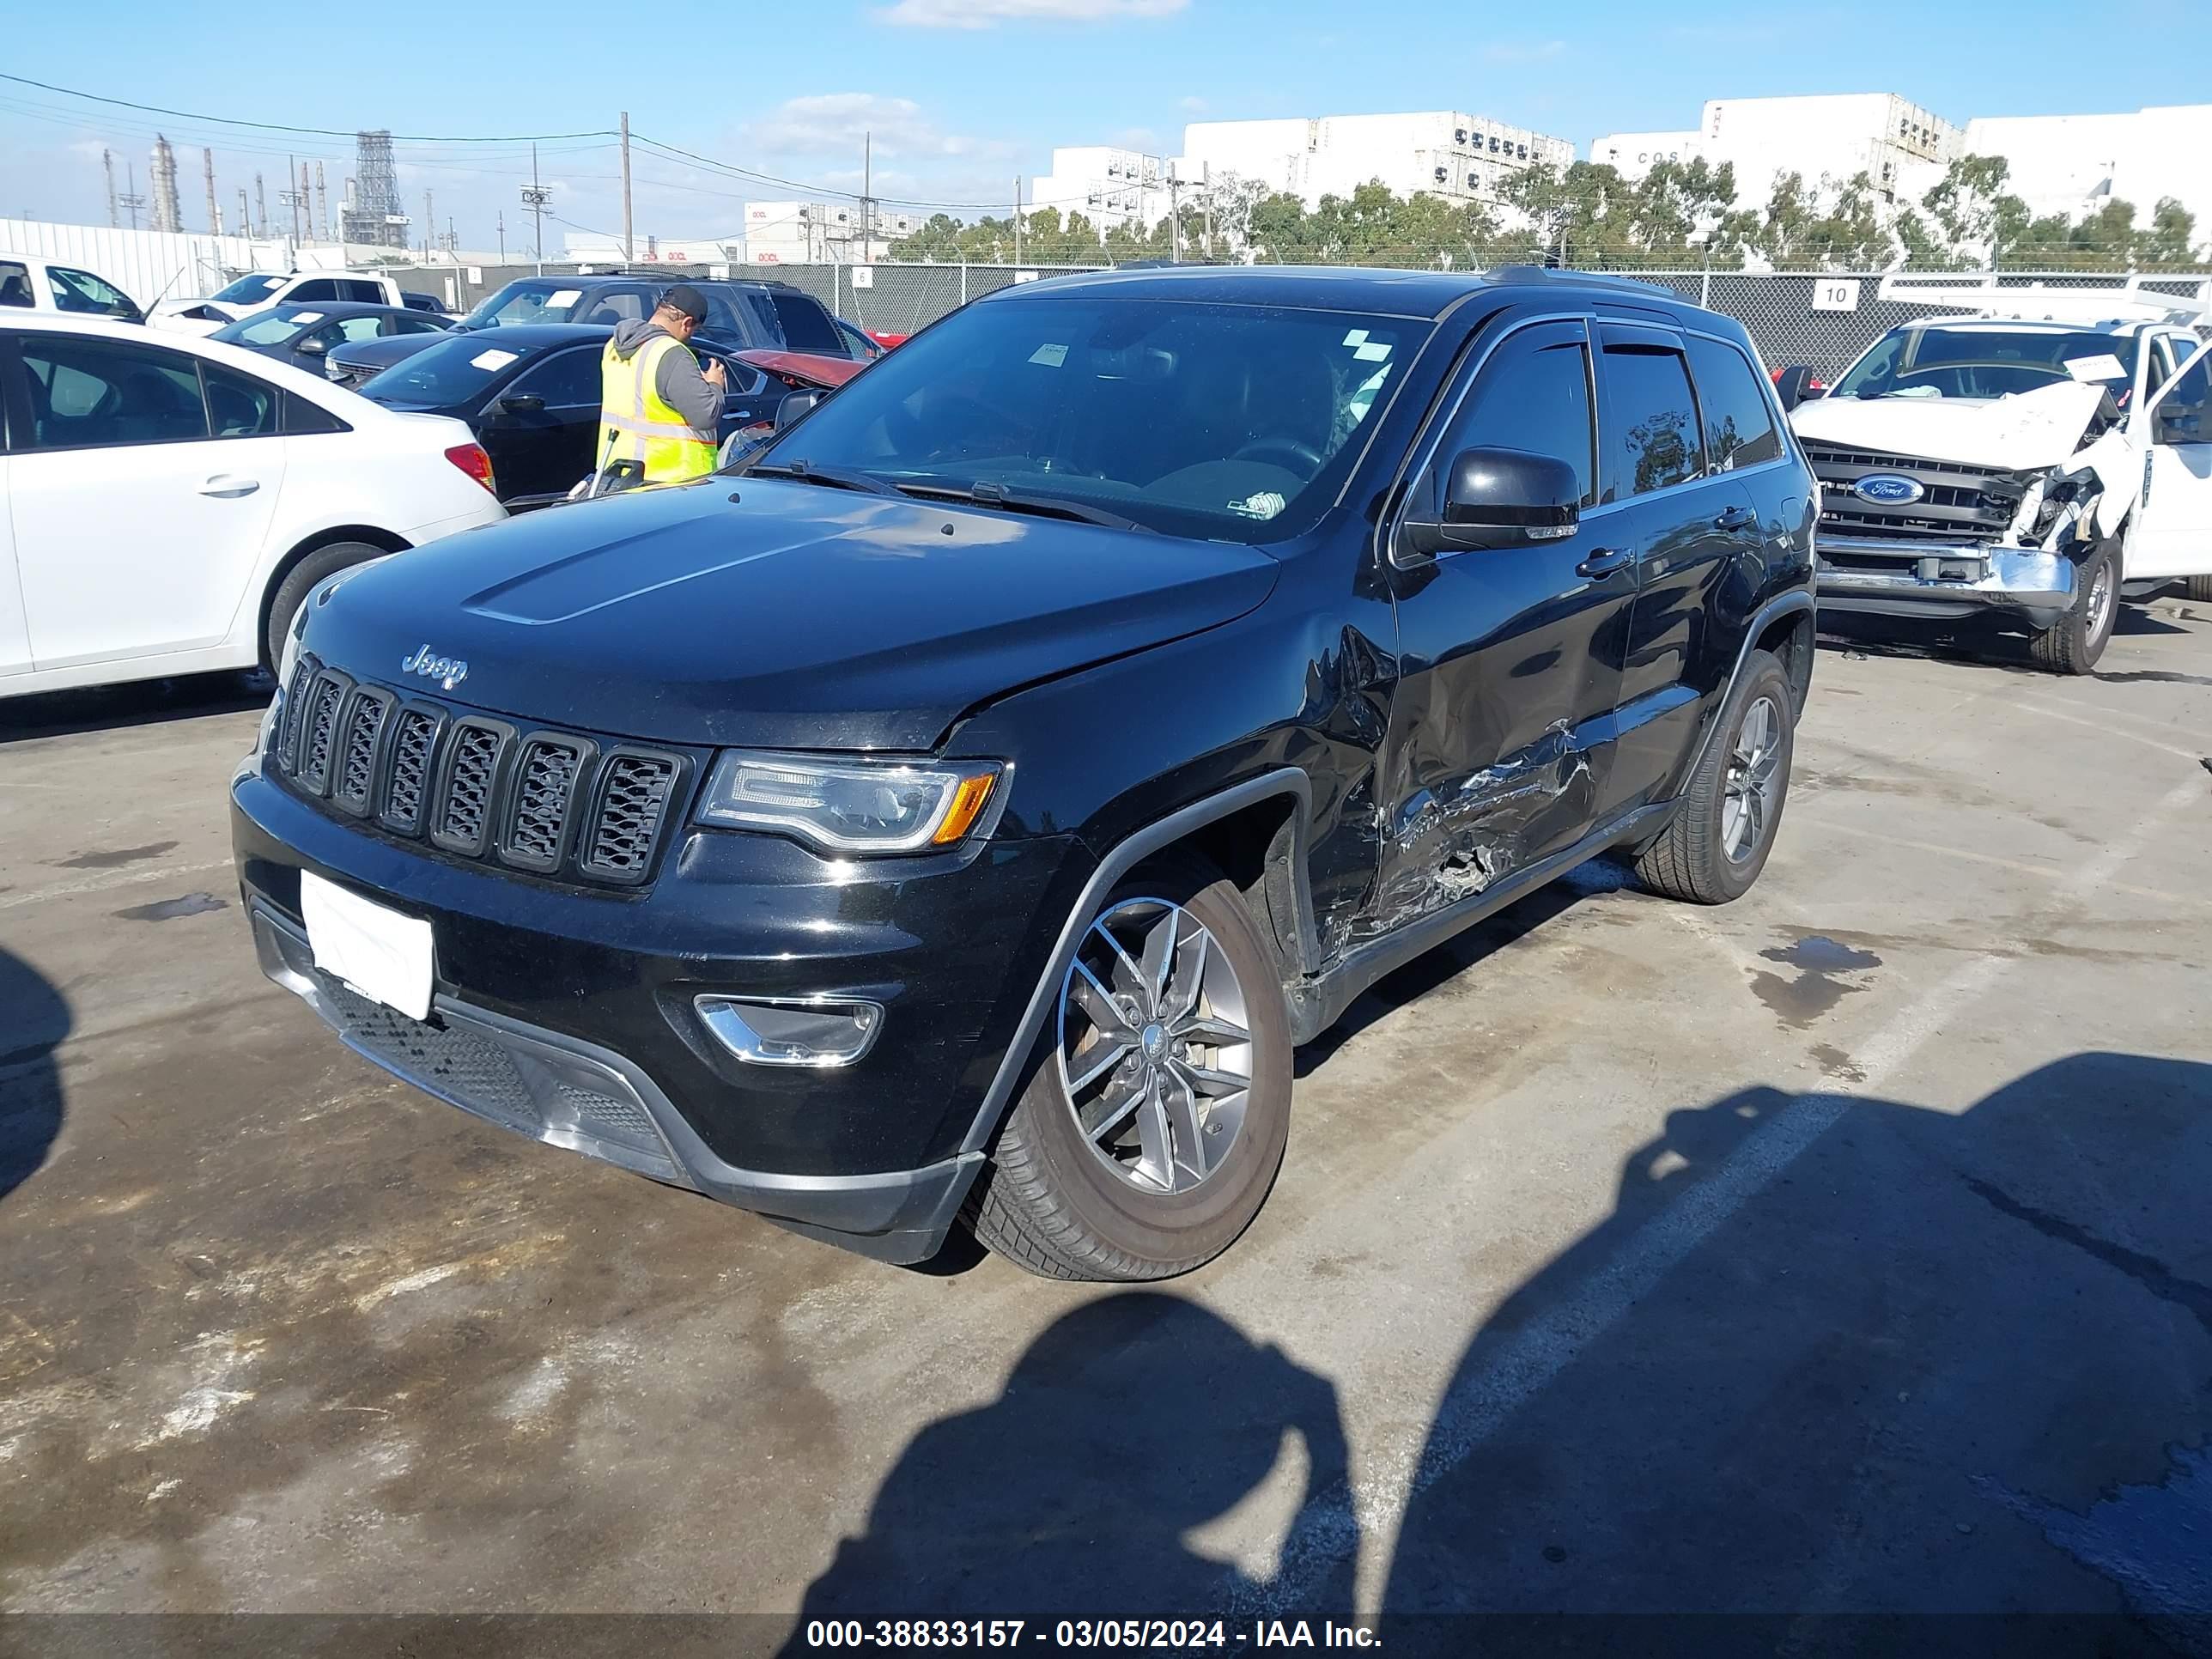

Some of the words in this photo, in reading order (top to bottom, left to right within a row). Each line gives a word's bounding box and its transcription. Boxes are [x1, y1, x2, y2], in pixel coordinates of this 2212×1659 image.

[1826, 288, 1847, 302] 10
[1871, 482, 1905, 496] Ford
[401, 643, 468, 691] Jeep
